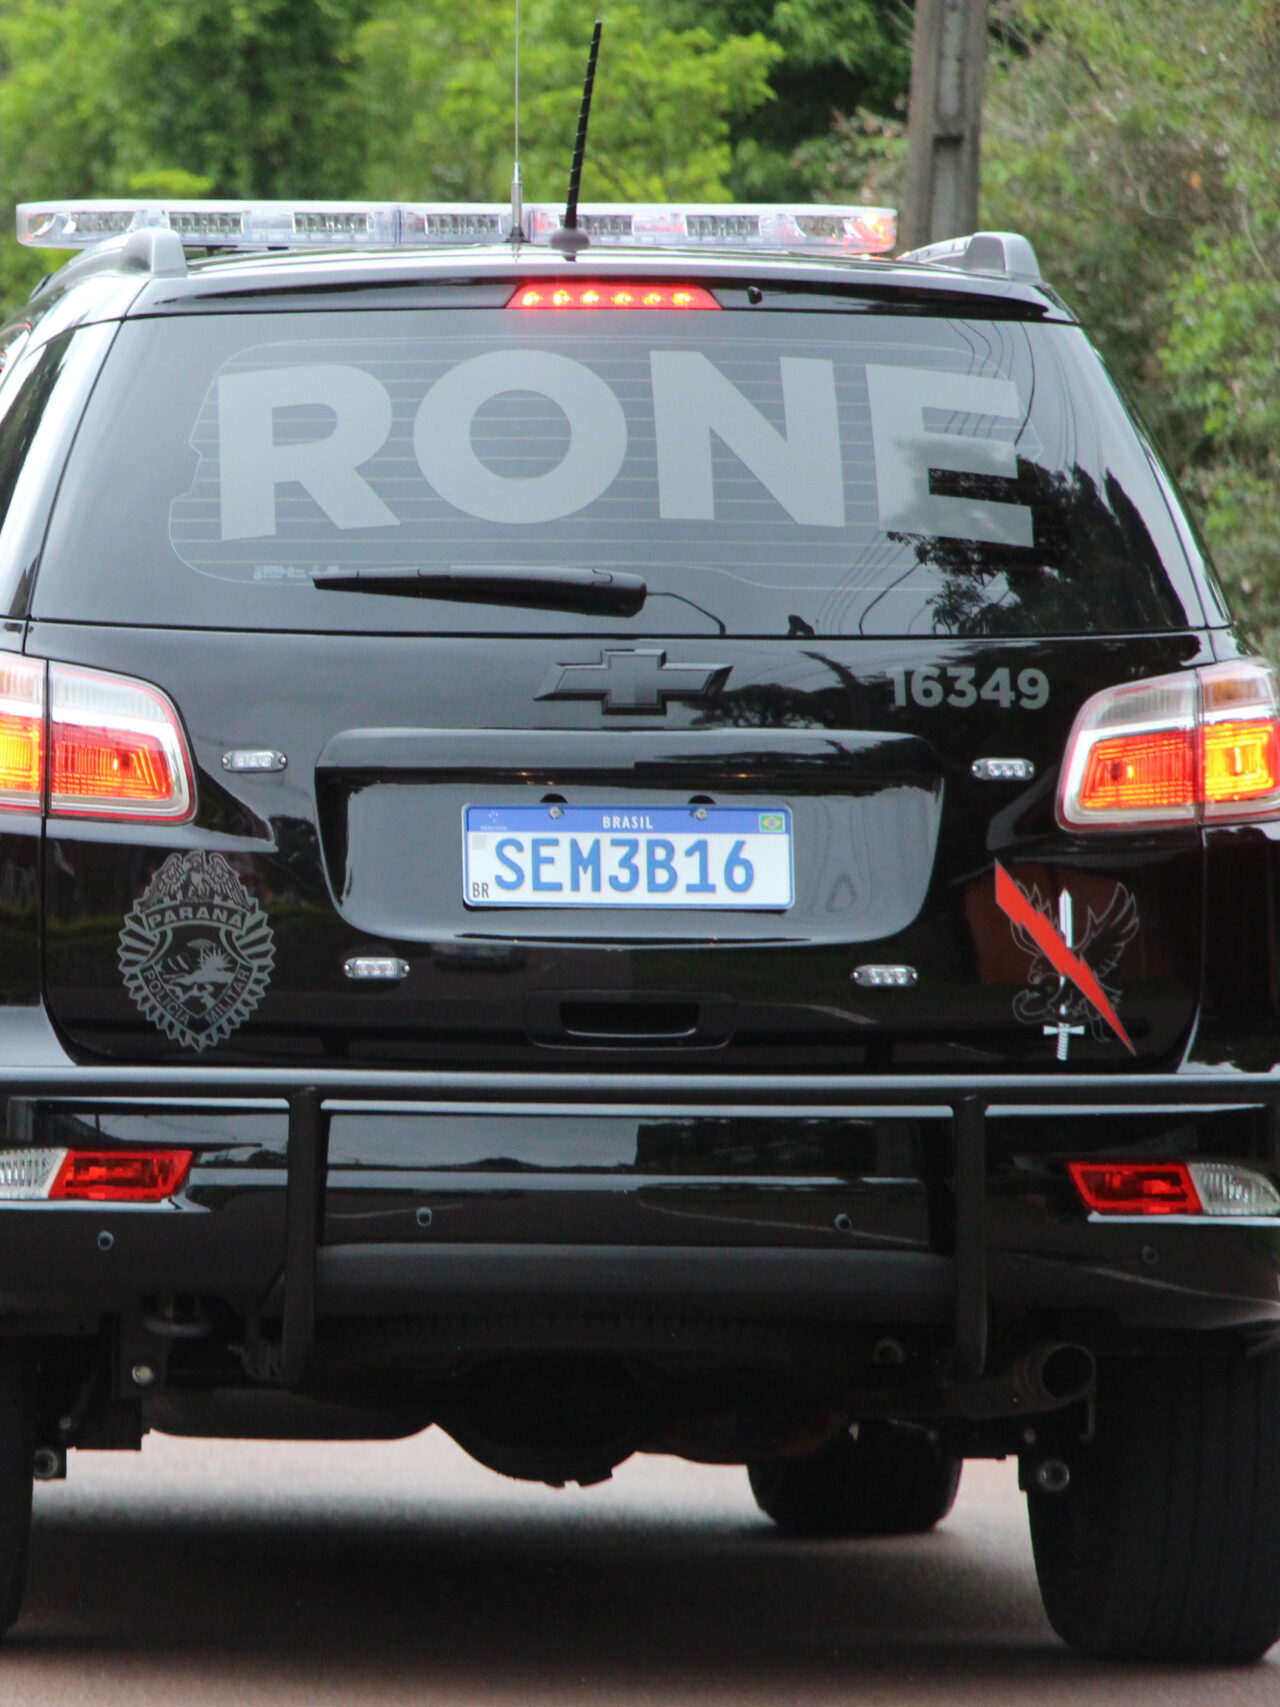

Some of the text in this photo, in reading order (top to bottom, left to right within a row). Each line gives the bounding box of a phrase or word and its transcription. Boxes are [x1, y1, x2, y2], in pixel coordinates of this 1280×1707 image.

[218, 348, 1035, 548] RONE
[886, 666, 1050, 710] 16349
[602, 815, 653, 830] BRASIL
[494, 837, 754, 893] SEM3B16
[472, 882, 490, 899] BR
[205, 969, 250, 1025] MILITAR
